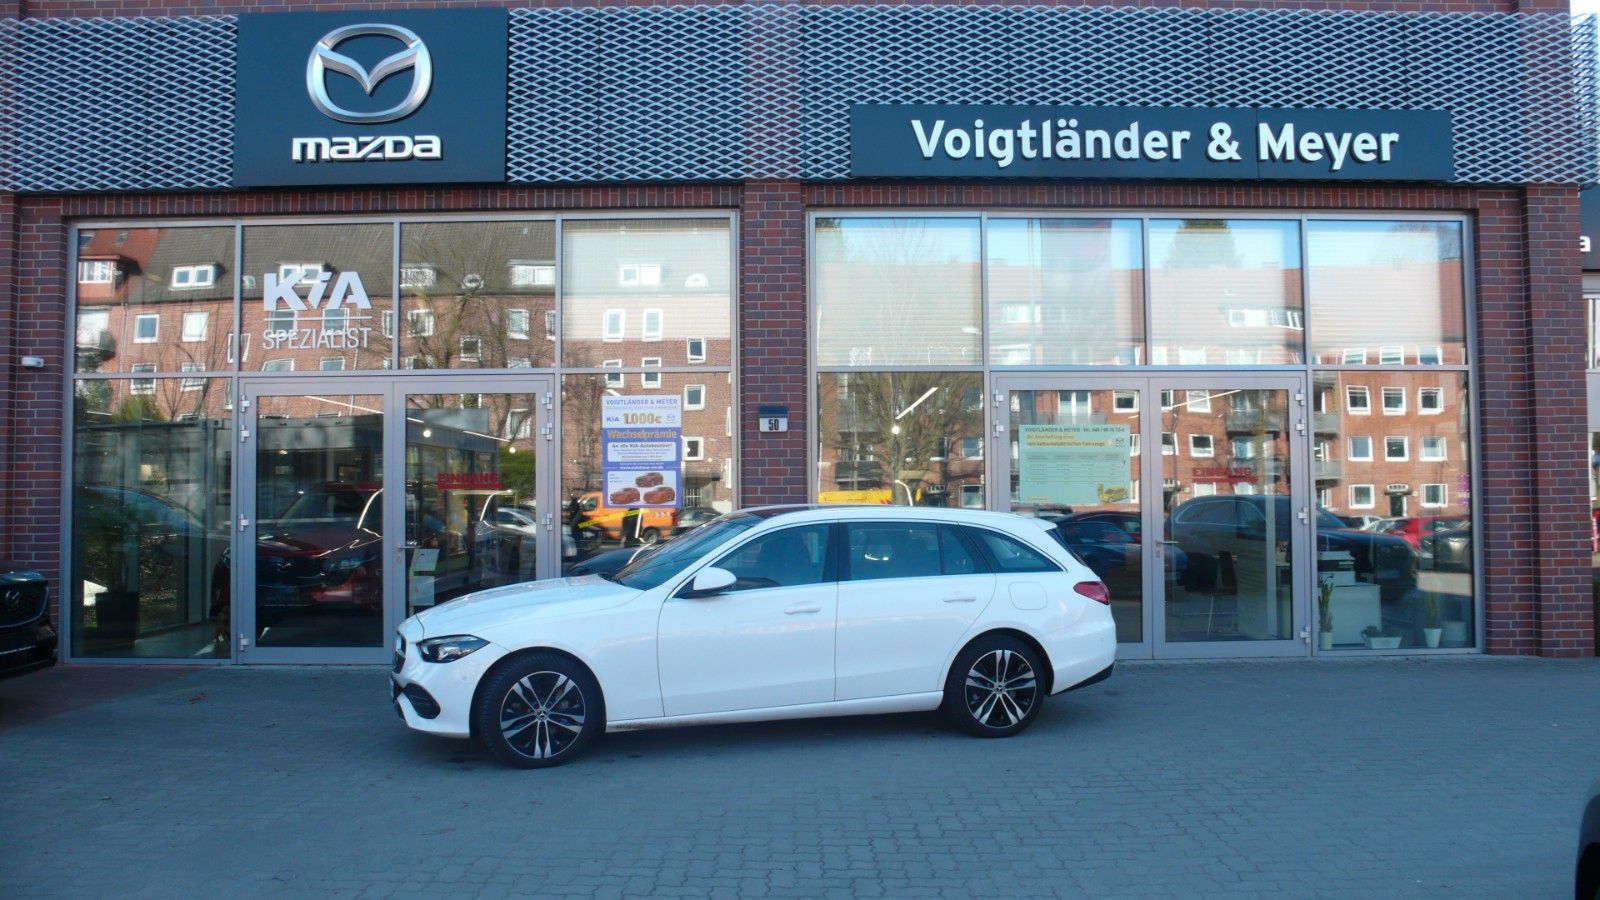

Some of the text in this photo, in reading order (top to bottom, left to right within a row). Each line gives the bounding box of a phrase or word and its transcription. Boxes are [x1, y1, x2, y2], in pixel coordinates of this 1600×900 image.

[292, 134, 441, 161] mazda
[911, 118, 1400, 170] Voigtländer & Meyer
[263, 271, 372, 311] KIA
[262, 327, 373, 350] SPEZIALIST
[607, 429, 677, 442] Wechselprämie
[768, 418, 780, 431] 50
[1193, 467, 1252, 478] EINGANG
